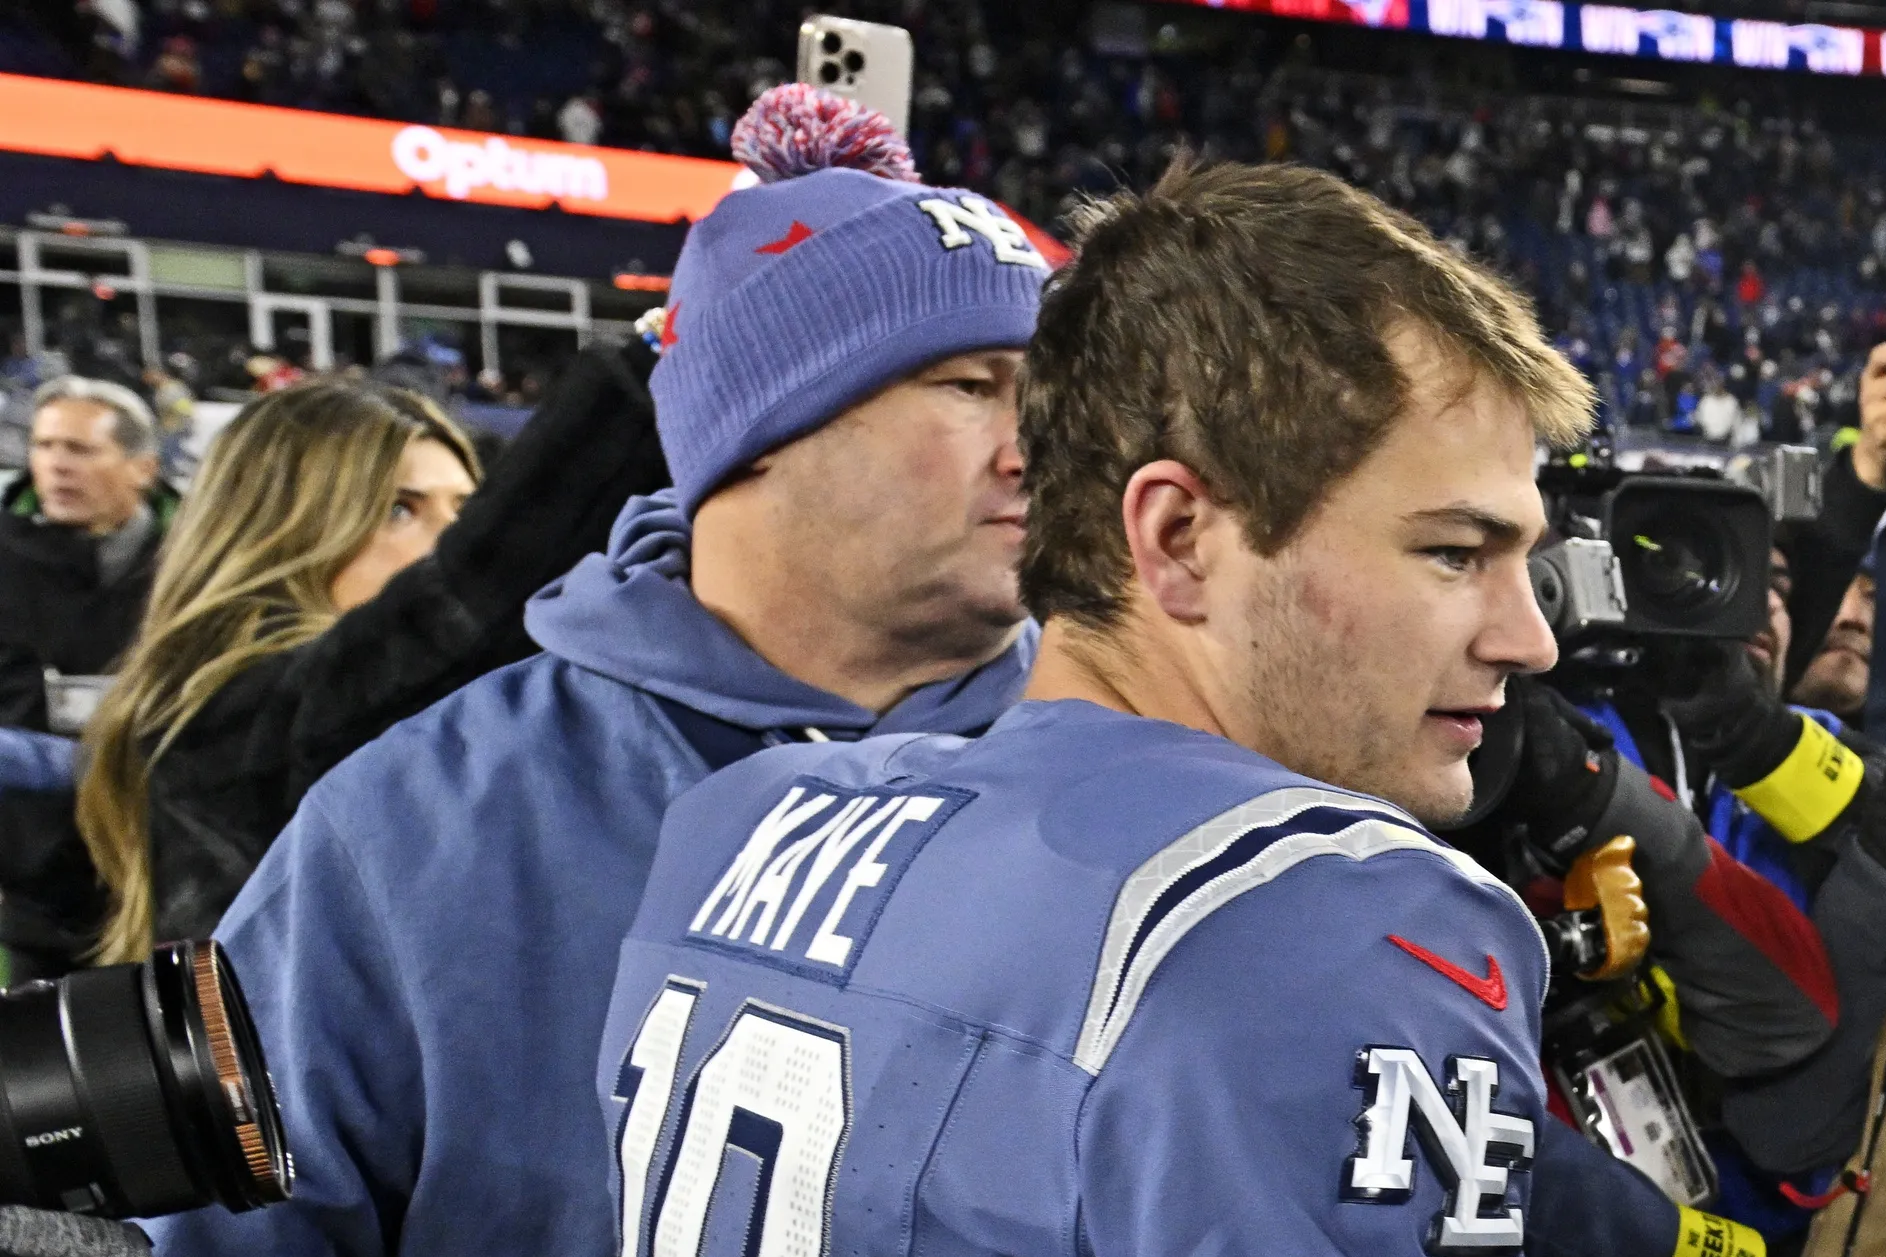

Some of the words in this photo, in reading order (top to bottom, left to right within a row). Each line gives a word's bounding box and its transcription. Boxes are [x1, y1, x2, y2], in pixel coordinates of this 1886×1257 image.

[391, 125, 608, 200] Optum
[917, 195, 1048, 269] NE
[689, 786, 945, 968] MAYE
[25, 1126, 83, 1148] SONY
